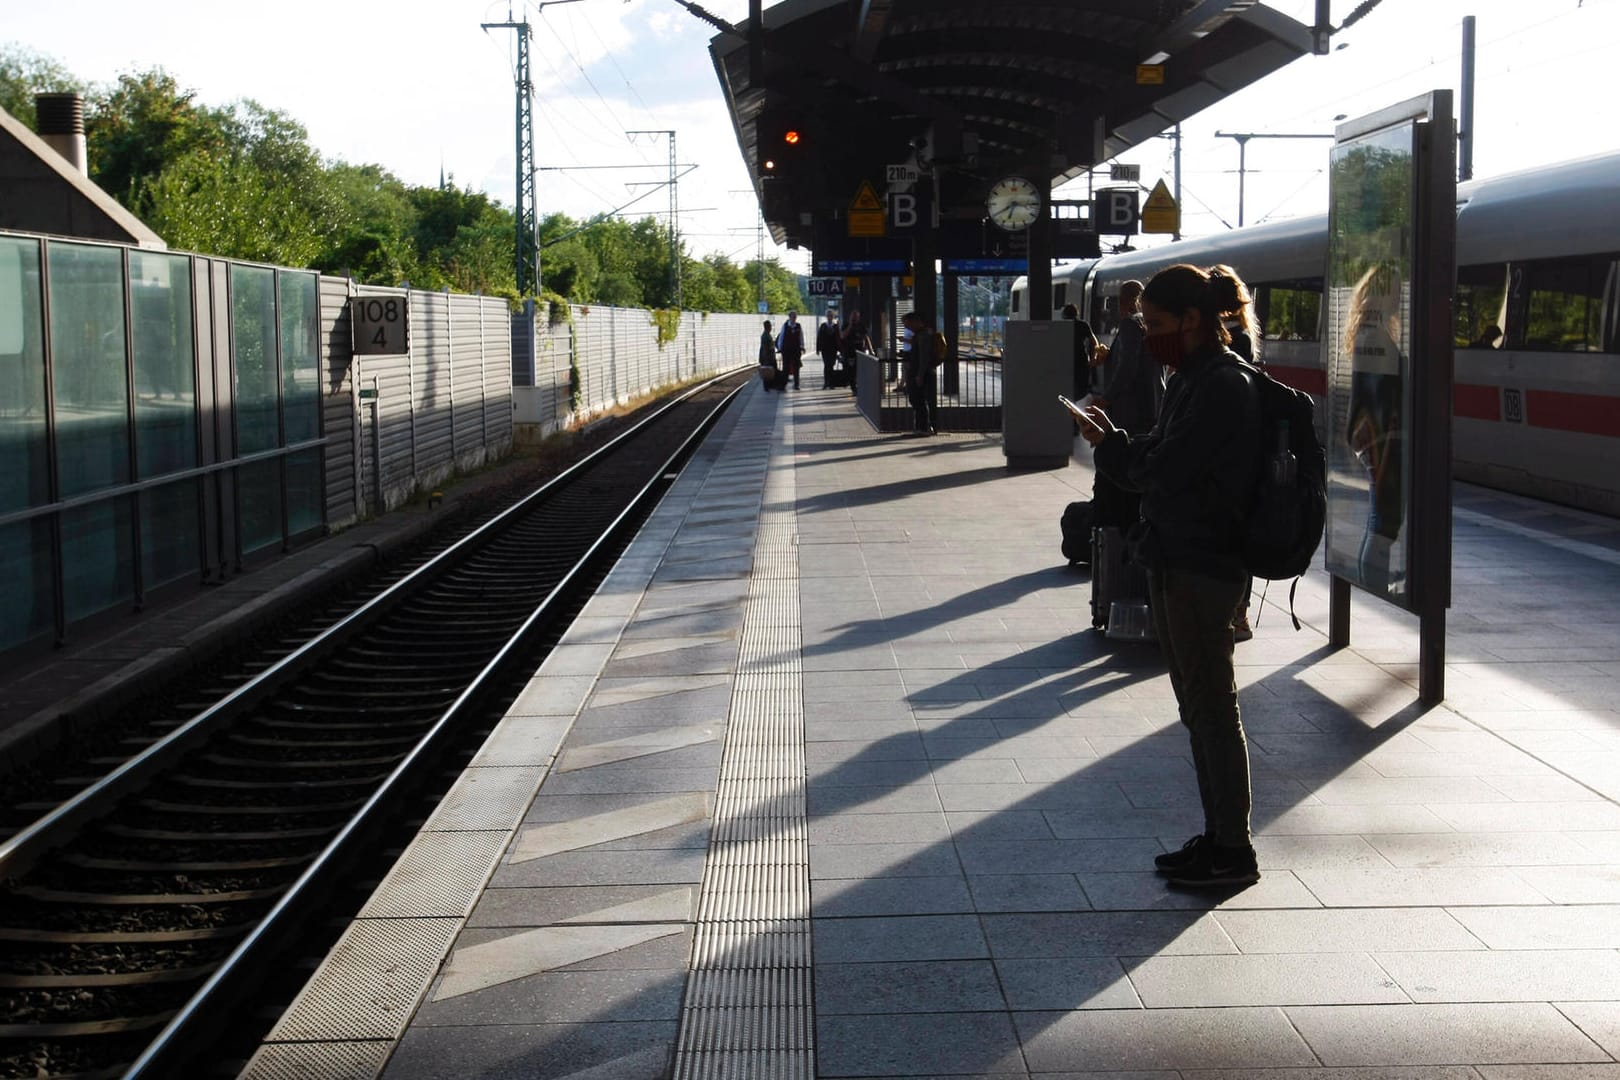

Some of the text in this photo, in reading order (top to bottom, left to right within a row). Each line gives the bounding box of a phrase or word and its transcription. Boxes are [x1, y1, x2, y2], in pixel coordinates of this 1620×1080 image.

[894, 194, 917, 227] B
[1110, 193, 1133, 225] B
[810, 281, 840, 293] 10 A
[358, 300, 398, 323] 108
[371, 326, 387, 348] 4
